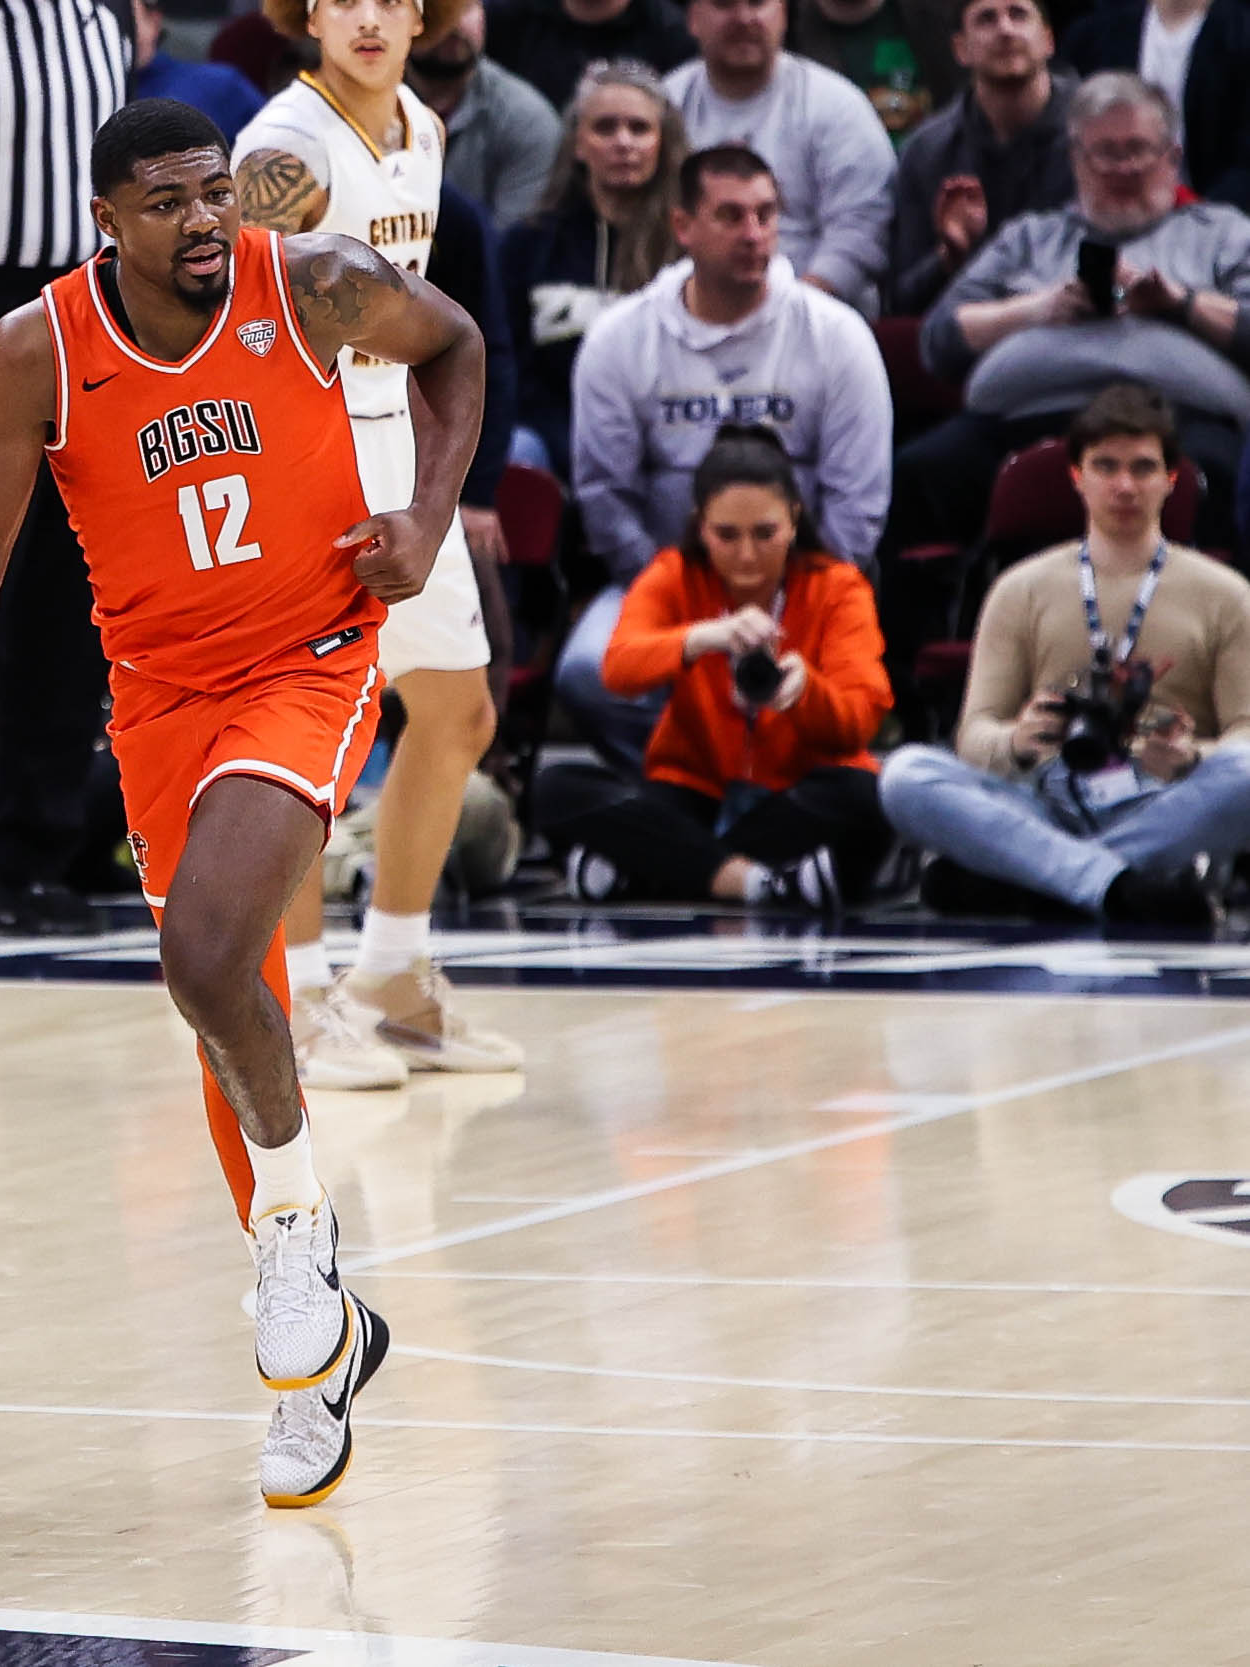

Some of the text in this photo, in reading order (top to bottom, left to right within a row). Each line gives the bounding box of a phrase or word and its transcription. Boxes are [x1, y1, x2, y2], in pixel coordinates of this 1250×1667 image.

[243, 328, 275, 345] MAC
[136, 399, 262, 483] BGSU
[178, 474, 262, 571] 12
